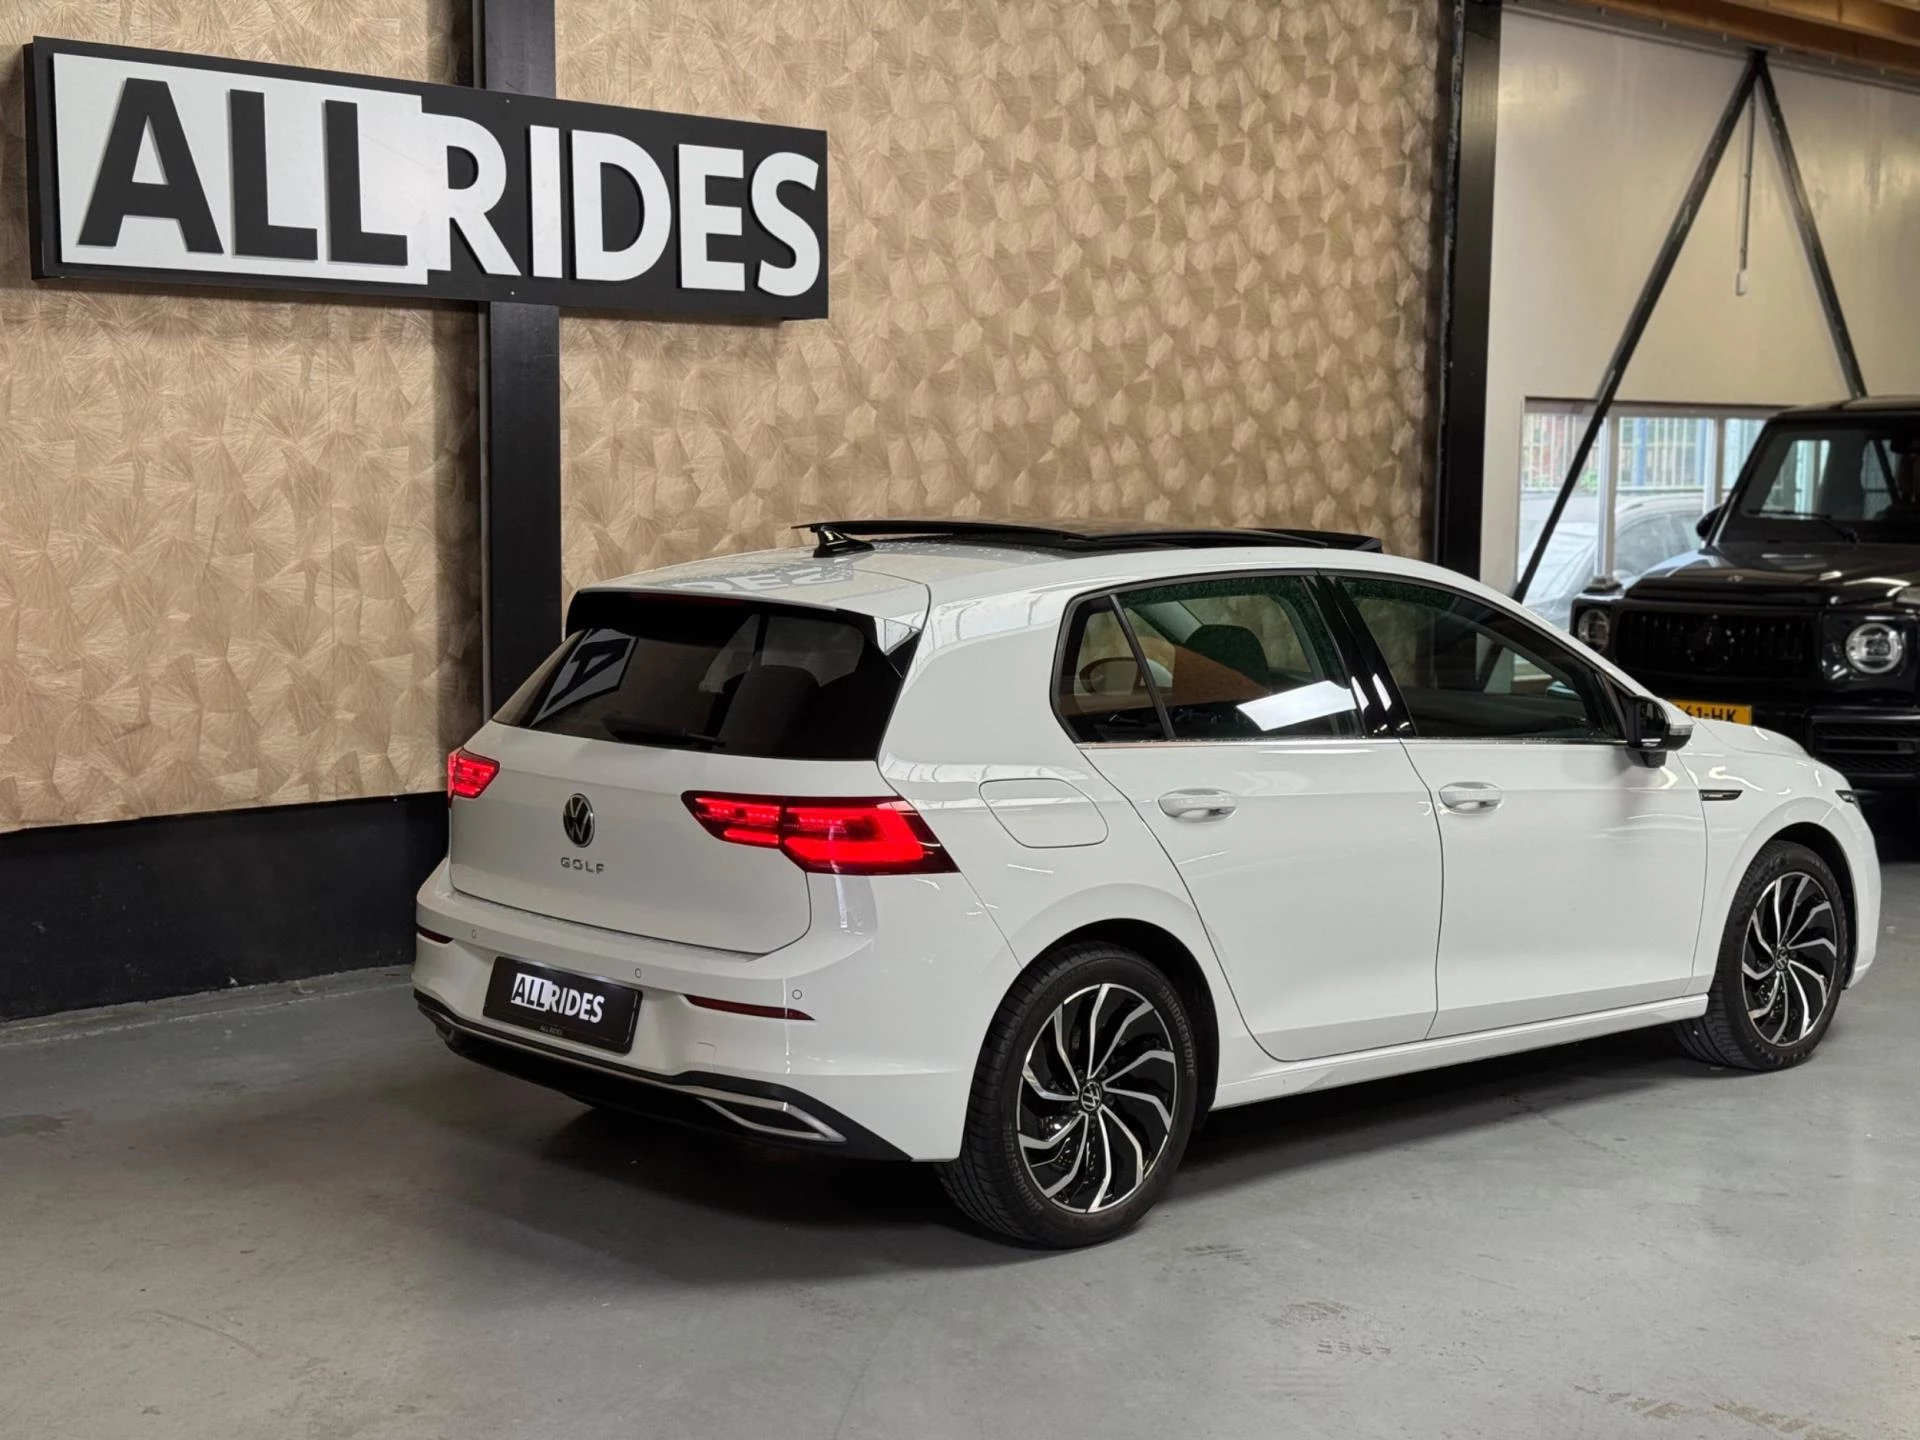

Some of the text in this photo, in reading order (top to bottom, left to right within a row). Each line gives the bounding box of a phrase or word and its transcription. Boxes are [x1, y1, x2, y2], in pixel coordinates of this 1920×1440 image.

[76, 77, 822, 297] ALLRIDES
[560, 856, 605, 874] GOLF
[512, 974, 605, 1024] ALLRIDES
